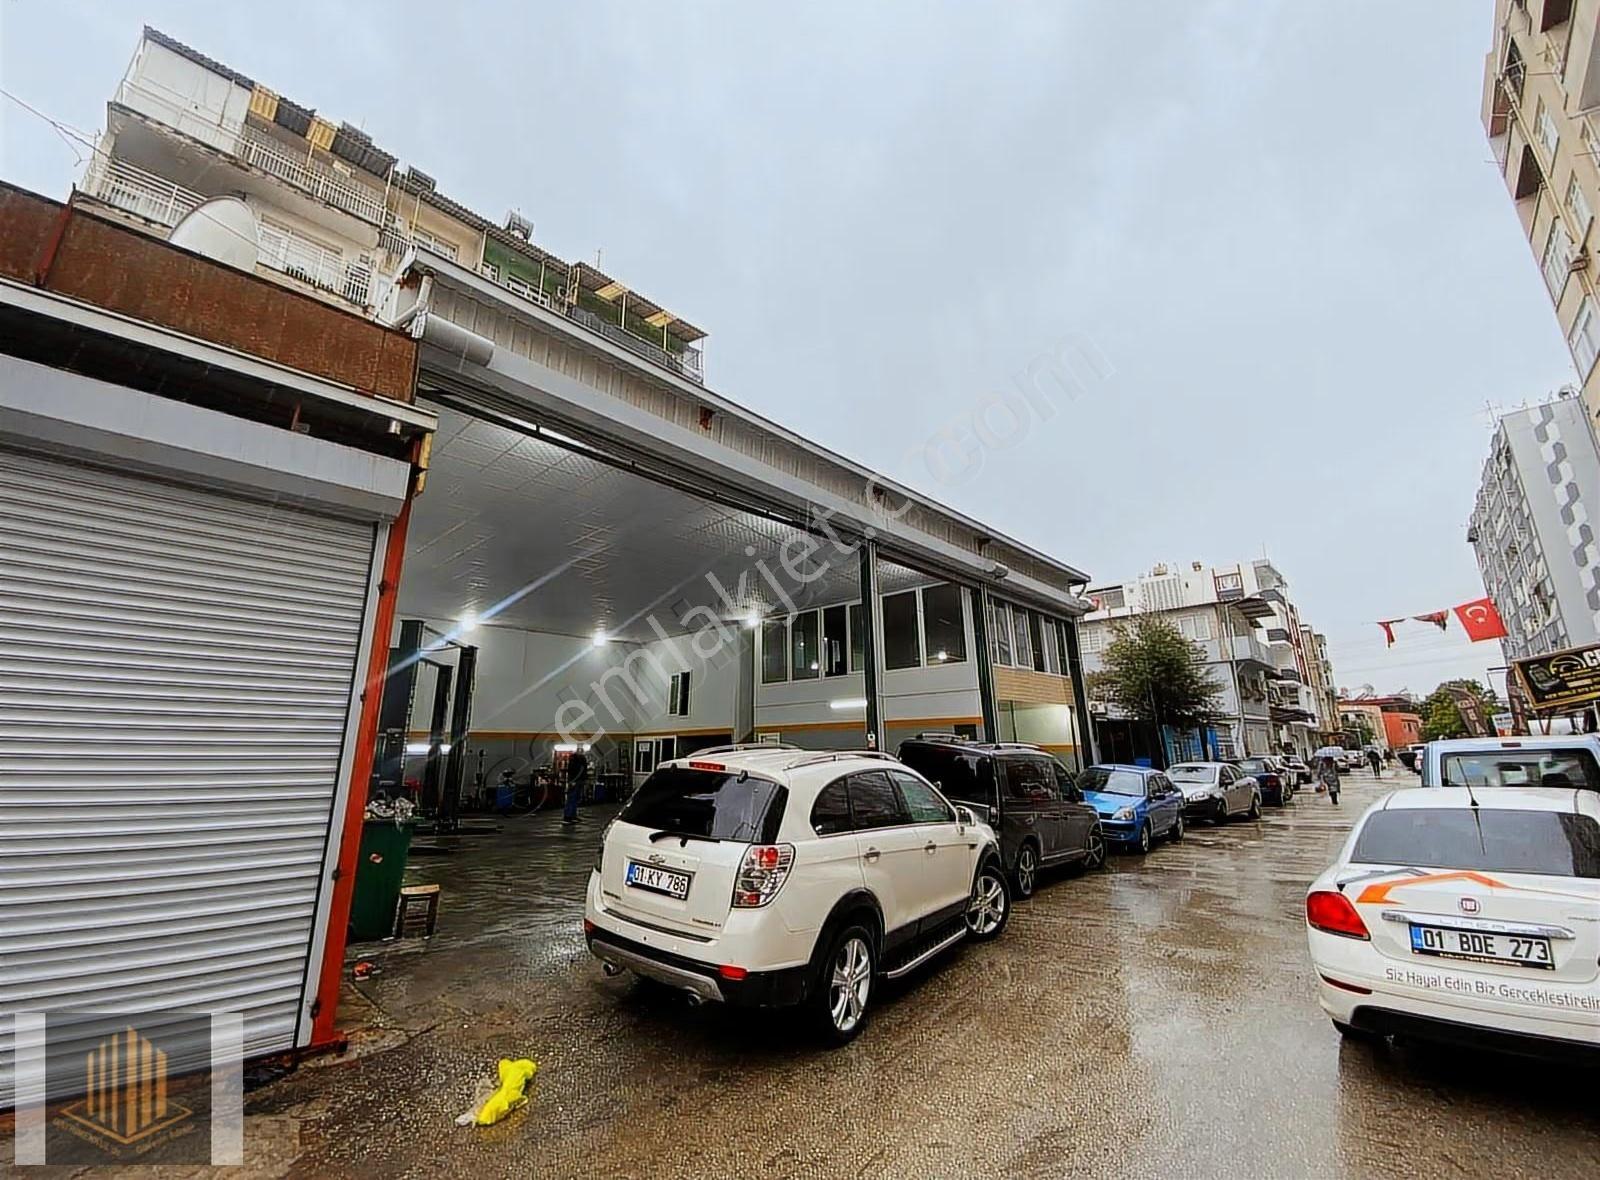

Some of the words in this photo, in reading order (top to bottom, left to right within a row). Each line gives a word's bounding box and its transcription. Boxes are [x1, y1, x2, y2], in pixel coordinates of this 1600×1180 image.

[634, 867, 645, 881] 01
[647, 869, 663, 886] KY
[1423, 930, 1444, 949] 01
[1459, 933, 1496, 955] BDE
[1509, 939, 1548, 961] 273
[1386, 968, 1403, 981] Siz
[1406, 971, 1441, 989] Hayal
[1444, 976, 1472, 992] Edin
[1475, 980, 1495, 996] Biz
